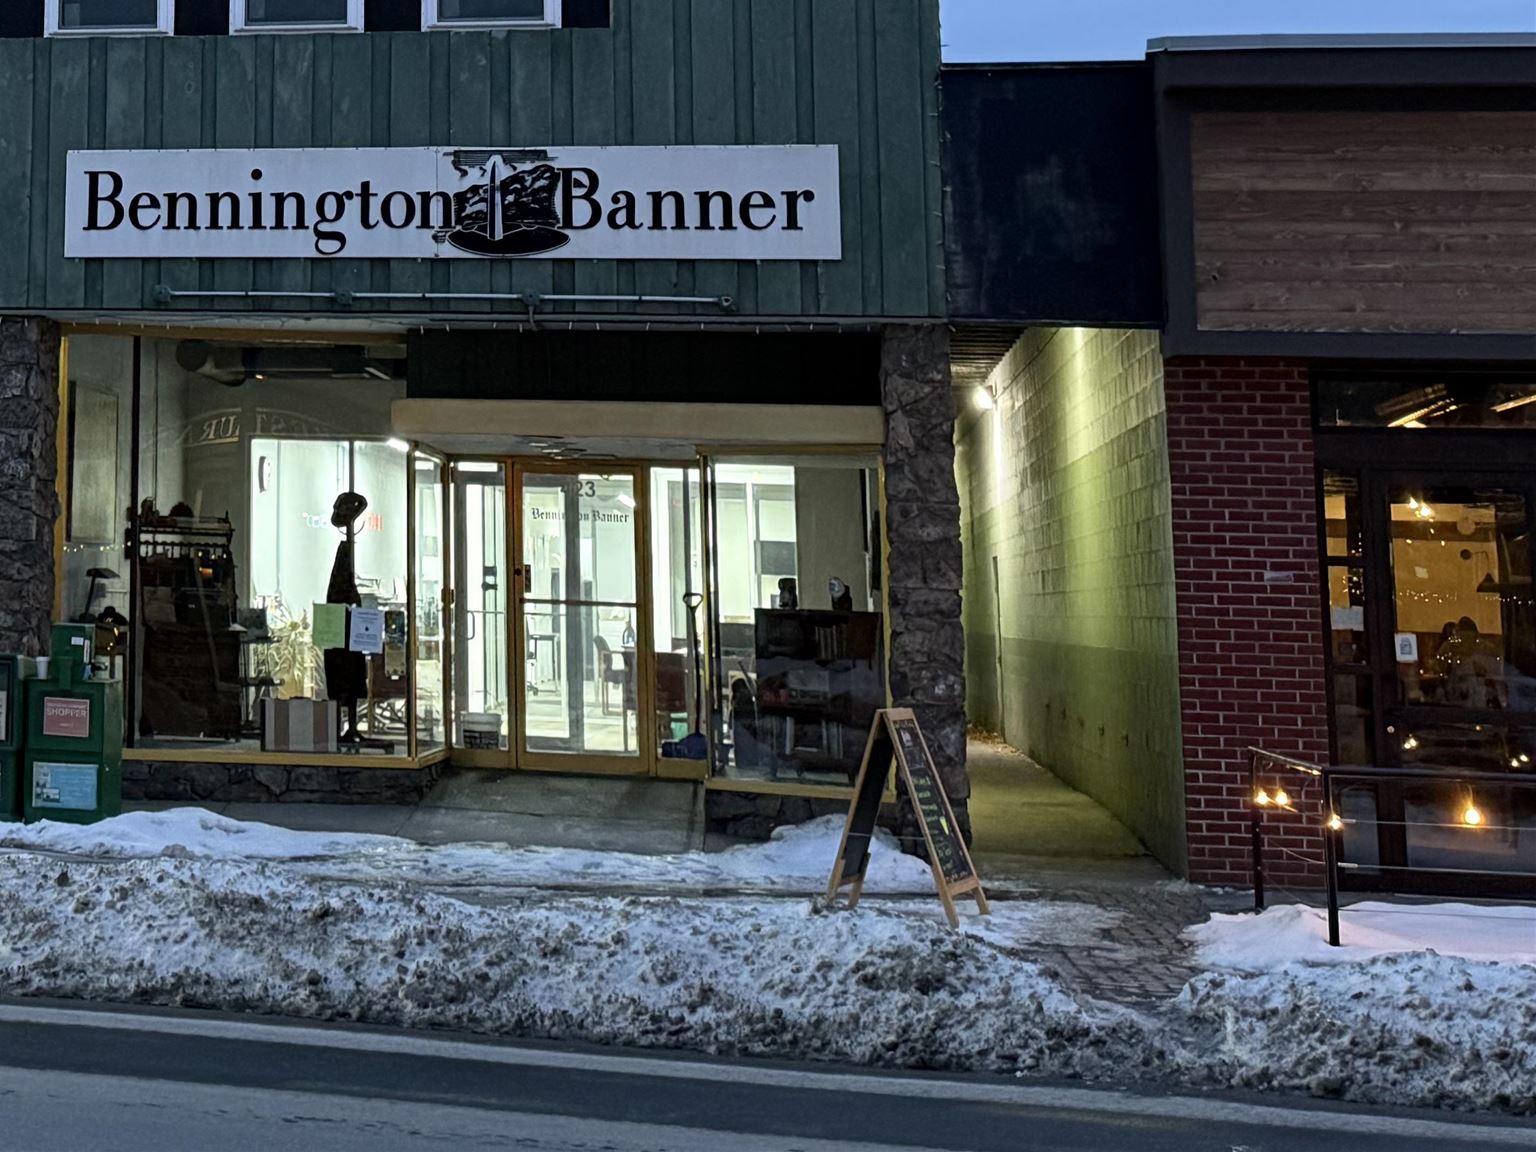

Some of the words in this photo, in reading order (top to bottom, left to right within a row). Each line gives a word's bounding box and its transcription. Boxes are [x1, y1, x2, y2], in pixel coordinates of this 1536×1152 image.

[82, 168, 463, 256] Bennington
[555, 167, 815, 232] Banner
[560, 480, 595, 498] 23
[591, 509, 629, 524] Banner
[47, 706, 87, 719] SHOPPER
